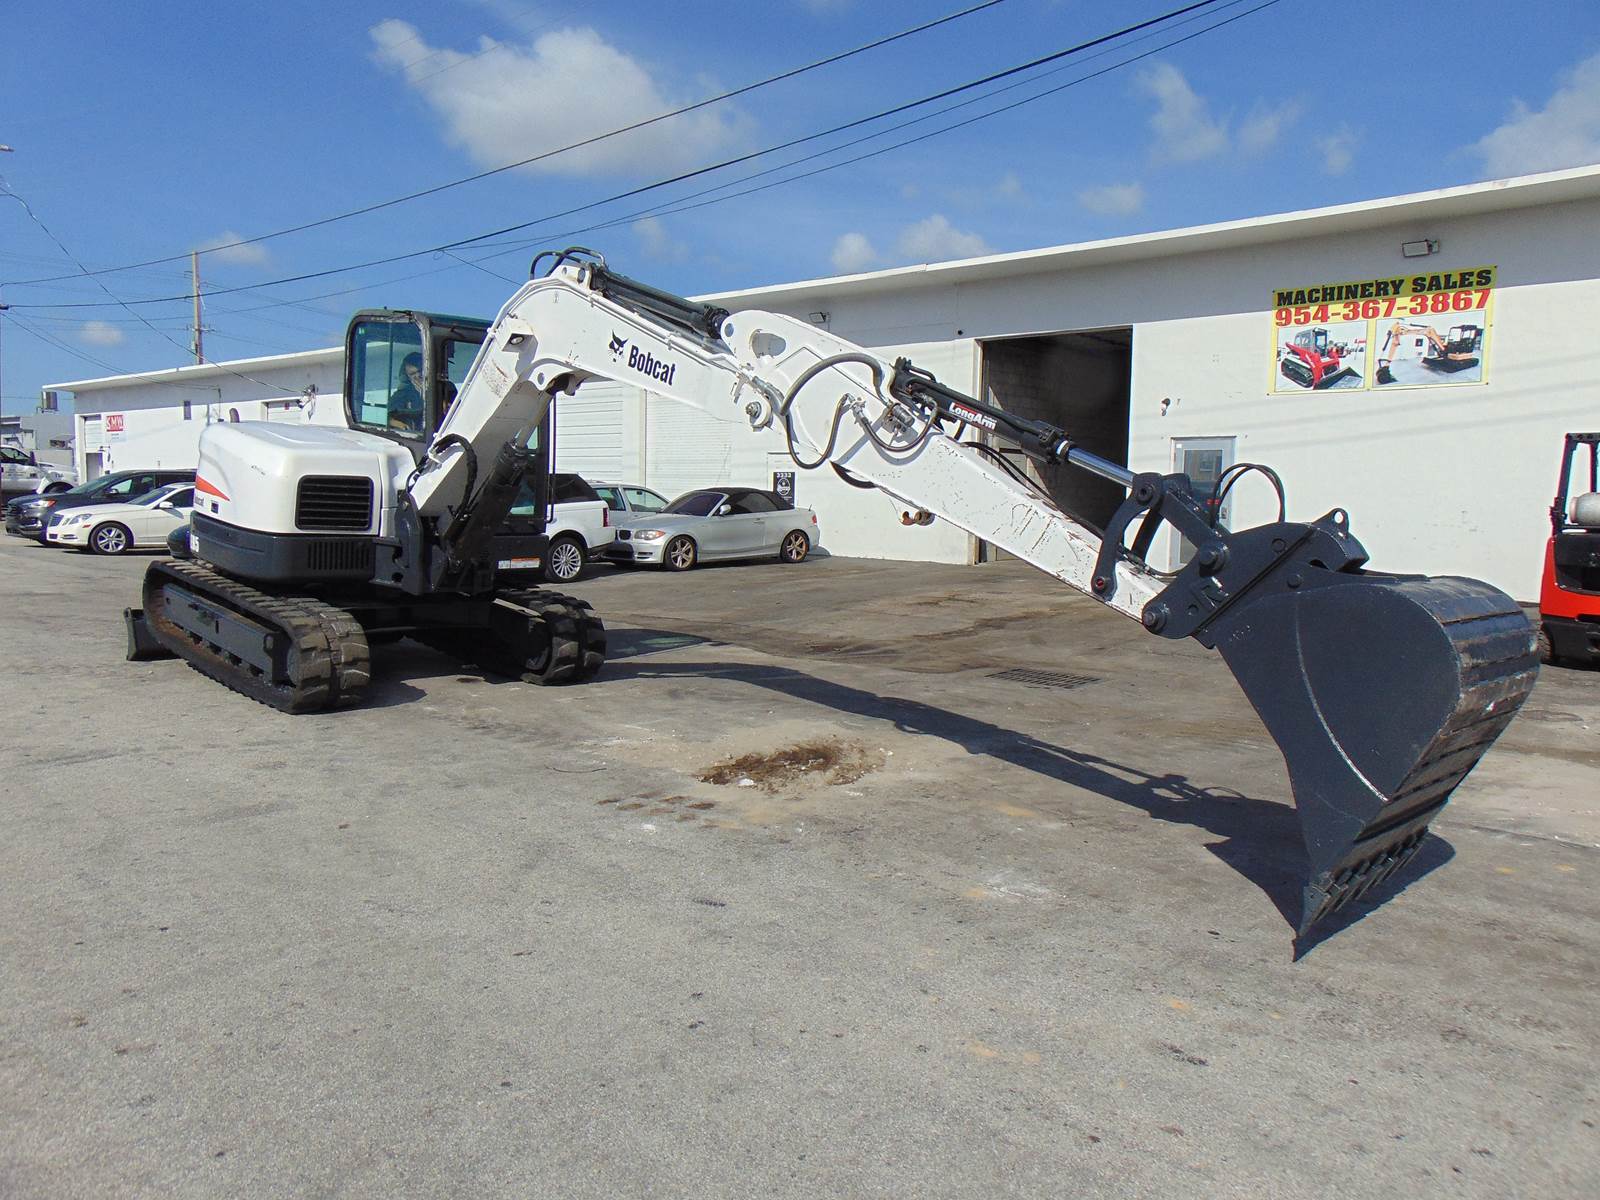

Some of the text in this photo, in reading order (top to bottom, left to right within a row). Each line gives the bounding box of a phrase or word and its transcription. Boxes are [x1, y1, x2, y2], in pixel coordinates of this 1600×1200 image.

[1276, 269, 1492, 306] MACHINERY SALES
[1275, 288, 1491, 327] 954-367-3867
[628, 344, 676, 386] Bobcat
[949, 402, 996, 430] LongArm
